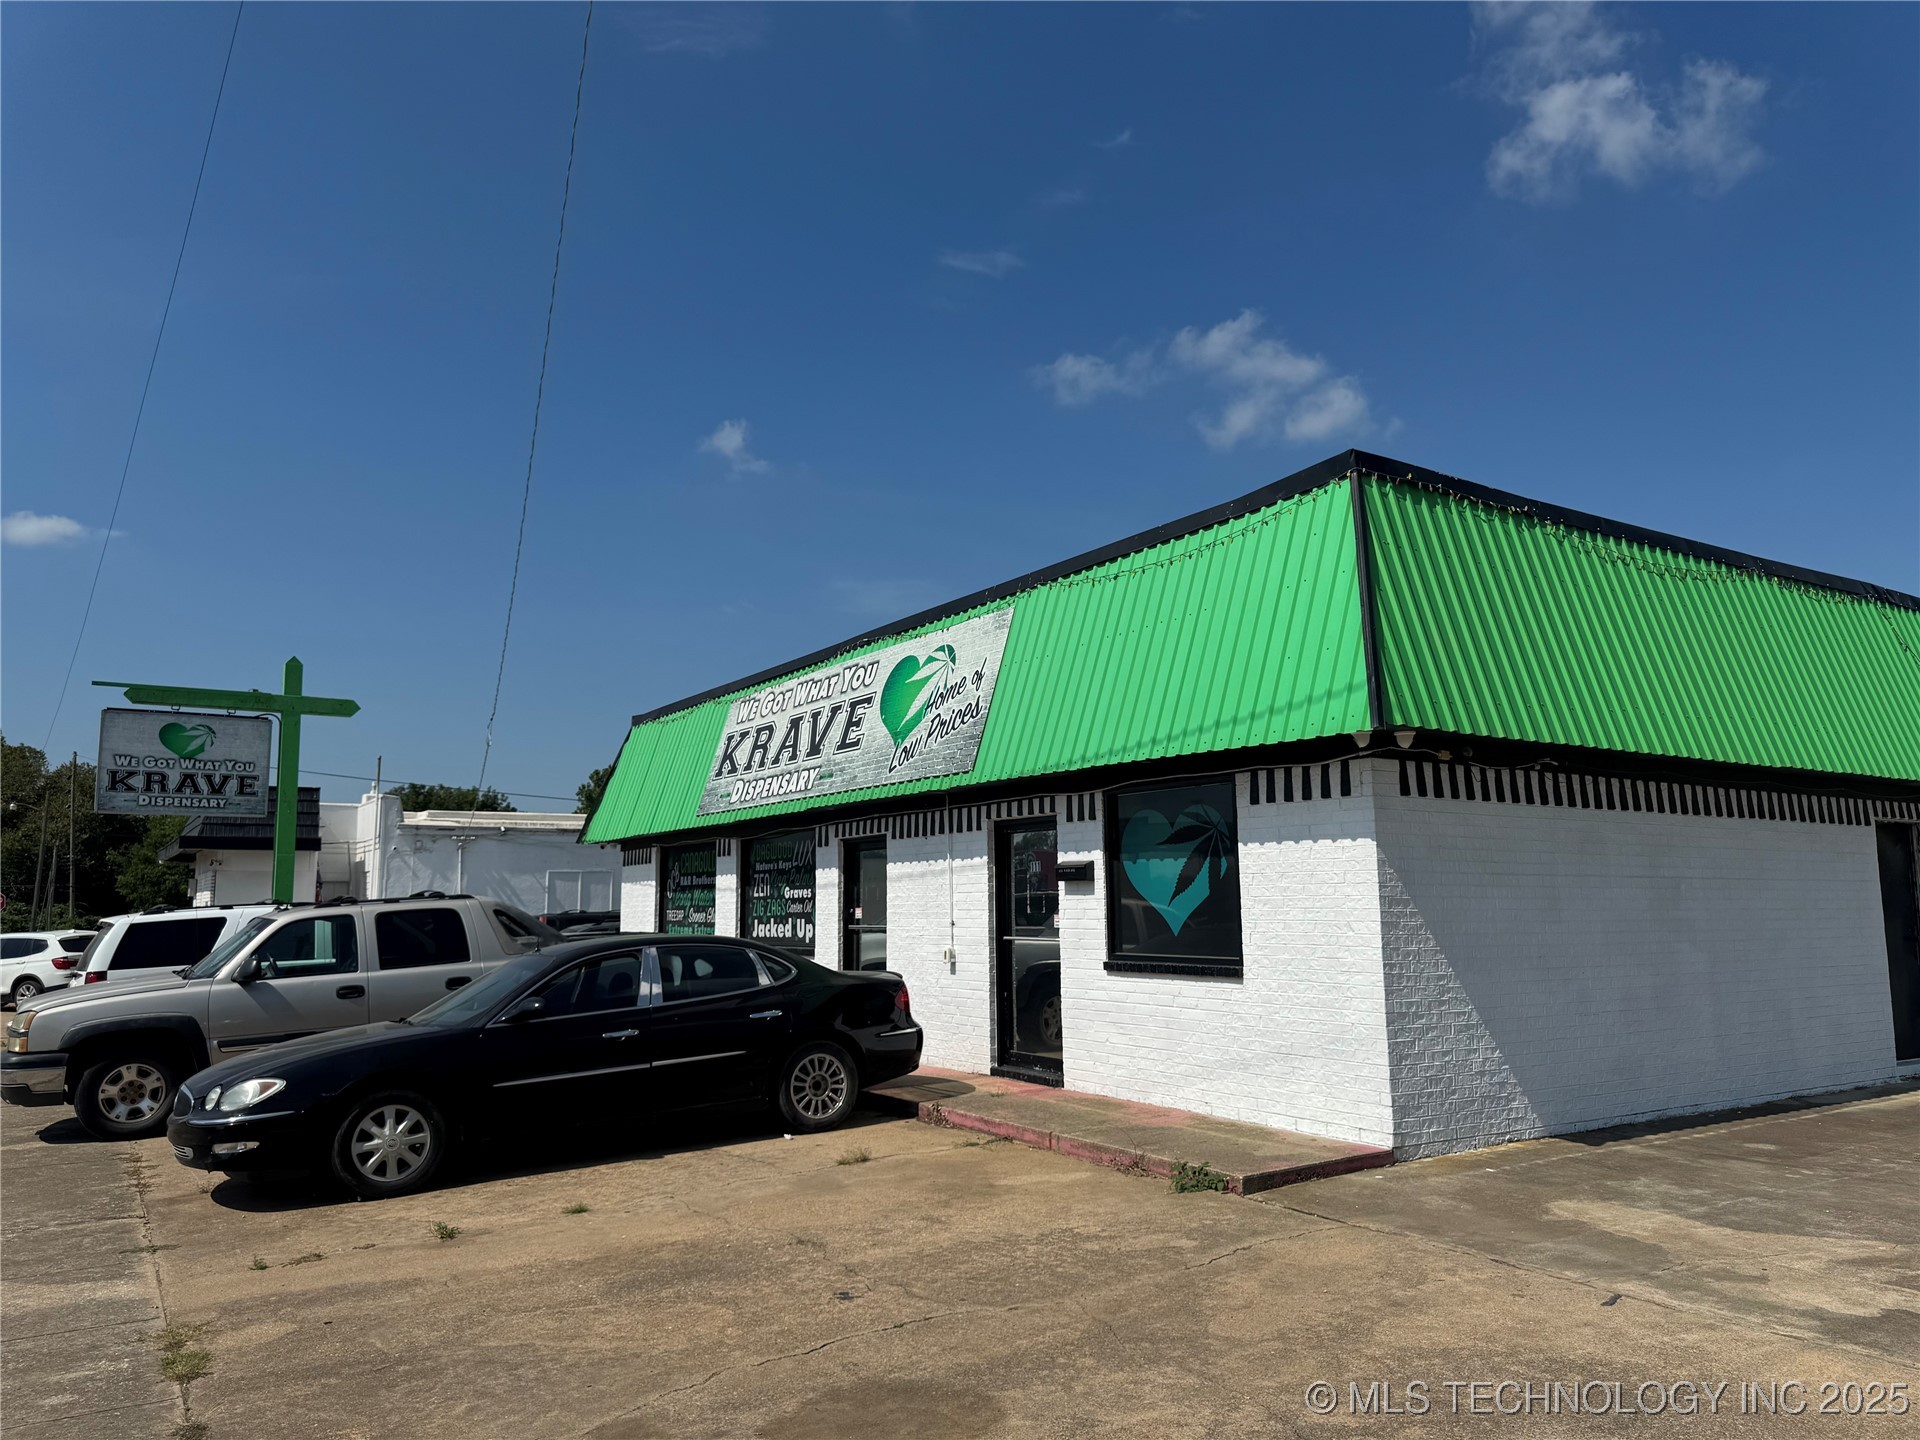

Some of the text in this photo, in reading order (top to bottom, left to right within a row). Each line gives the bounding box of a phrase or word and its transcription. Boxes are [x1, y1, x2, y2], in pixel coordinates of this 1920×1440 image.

[736, 660, 880, 724] WE GOT WHAT YOU
[924, 657, 988, 718] Home of
[712, 691, 877, 781] KRAVE
[888, 695, 984, 774] Low Prices
[114, 755, 255, 772] WE GOT WHAT YOU
[106, 769, 260, 797] KRAVE
[728, 767, 822, 805] DISPENSARY
[138, 795, 227, 808] DISPENSARY
[752, 898, 786, 916] ZIG ZAGS
[784, 887, 812, 899] Graves
[752, 918, 813, 943] Jacked Up
